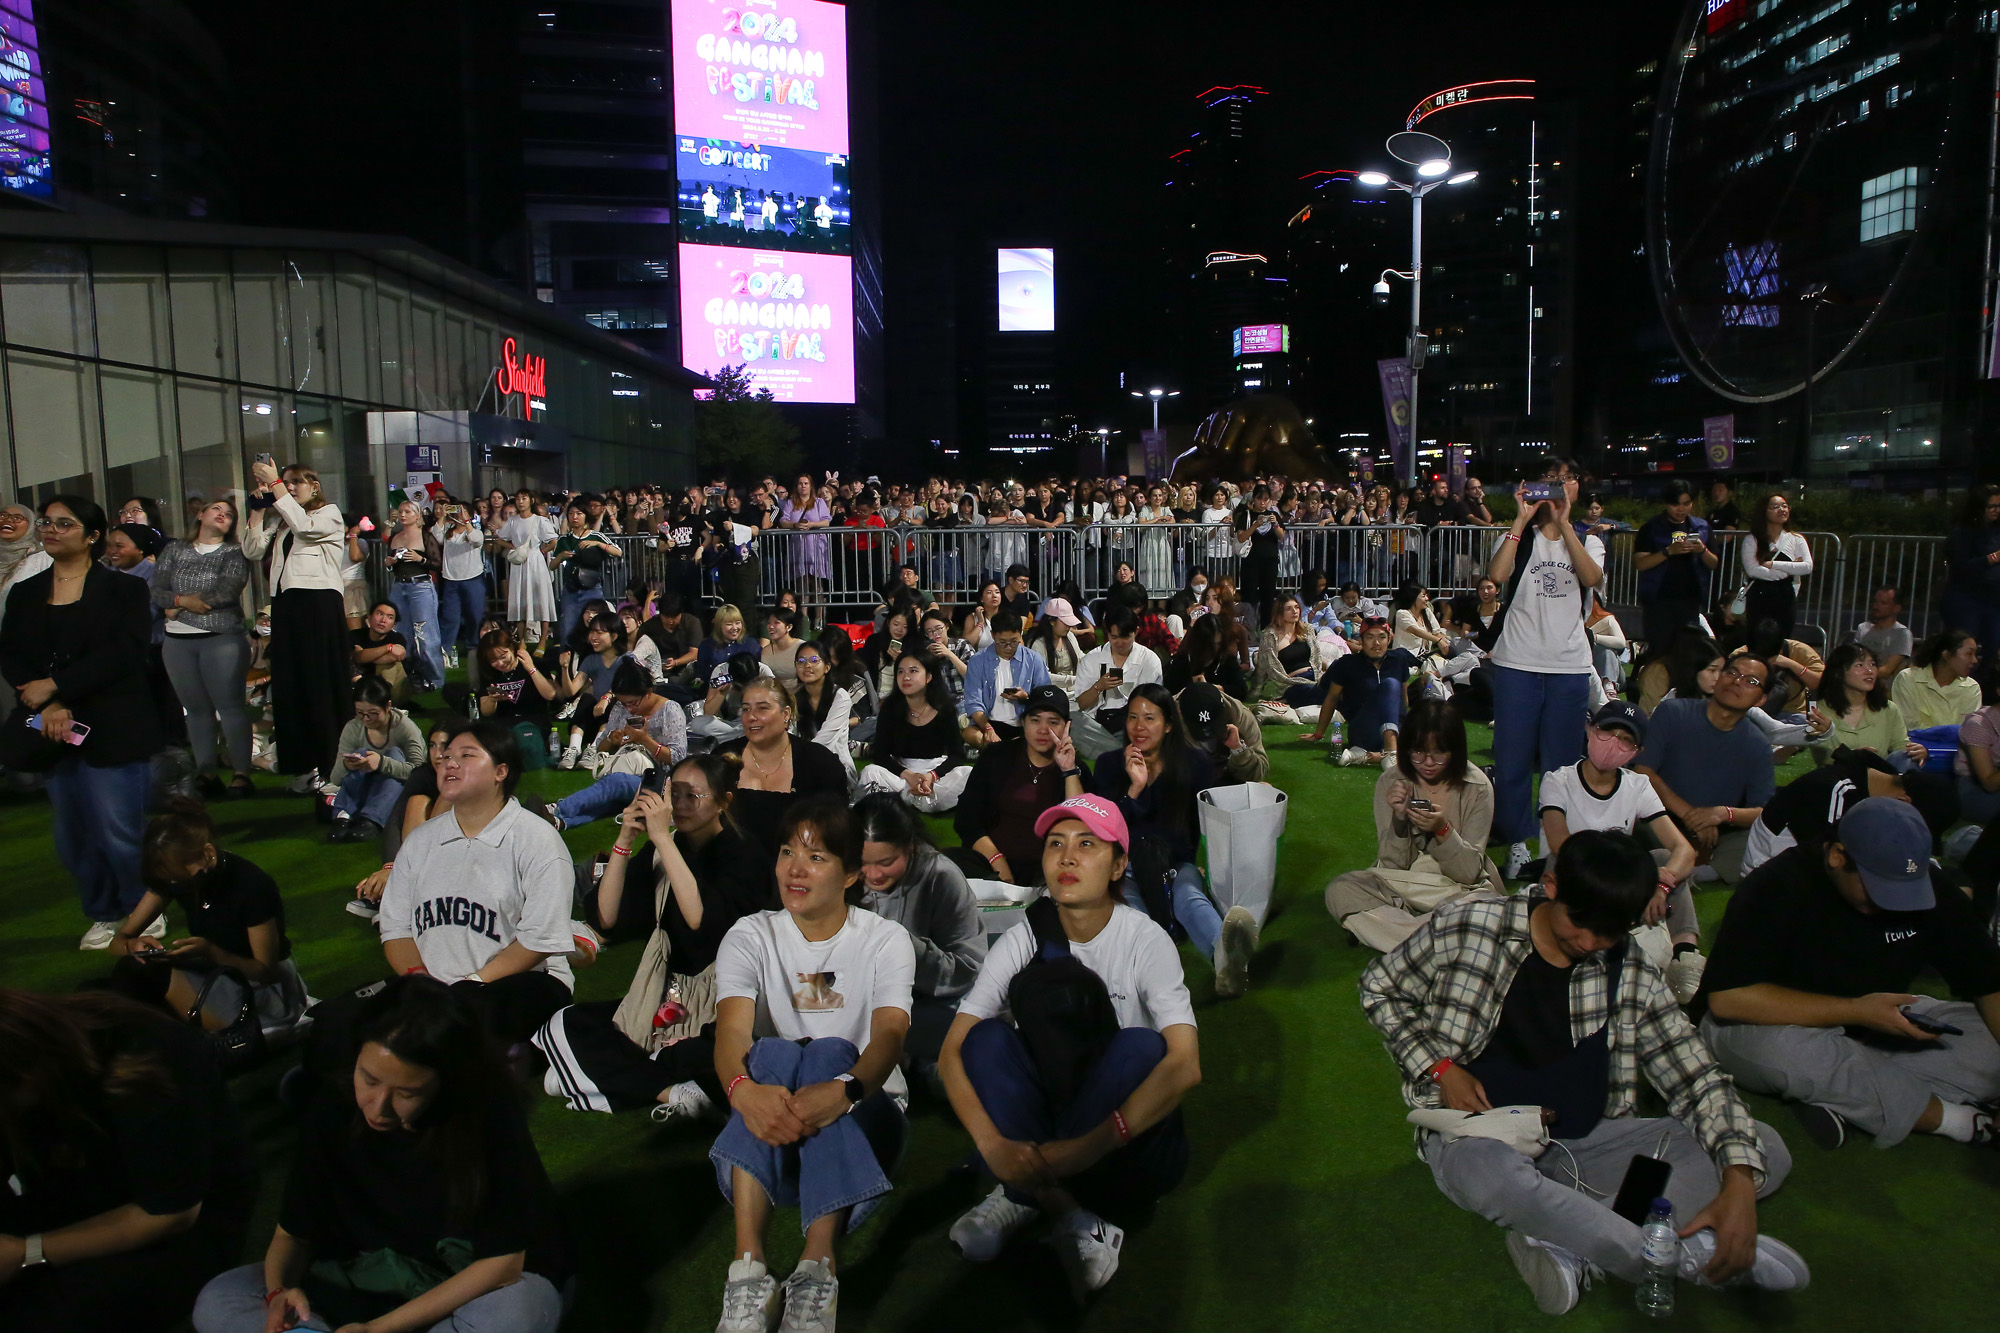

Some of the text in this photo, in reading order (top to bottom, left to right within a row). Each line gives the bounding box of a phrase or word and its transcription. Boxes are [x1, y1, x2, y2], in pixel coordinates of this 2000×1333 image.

[722, 7, 798, 43] 2024
[696, 33, 825, 78] GANGNAM
[730, 270, 805, 300] 2024
[704, 297, 831, 330] GANGNAM
[497, 337, 546, 421] Starfield
[1557, 562, 1576, 575] CLUB
[502, 682, 522, 691] GUESS
[1198, 710, 1211, 722] NY
[1624, 707, 1635, 717] NY
[1906, 858, 1918, 873] LA
